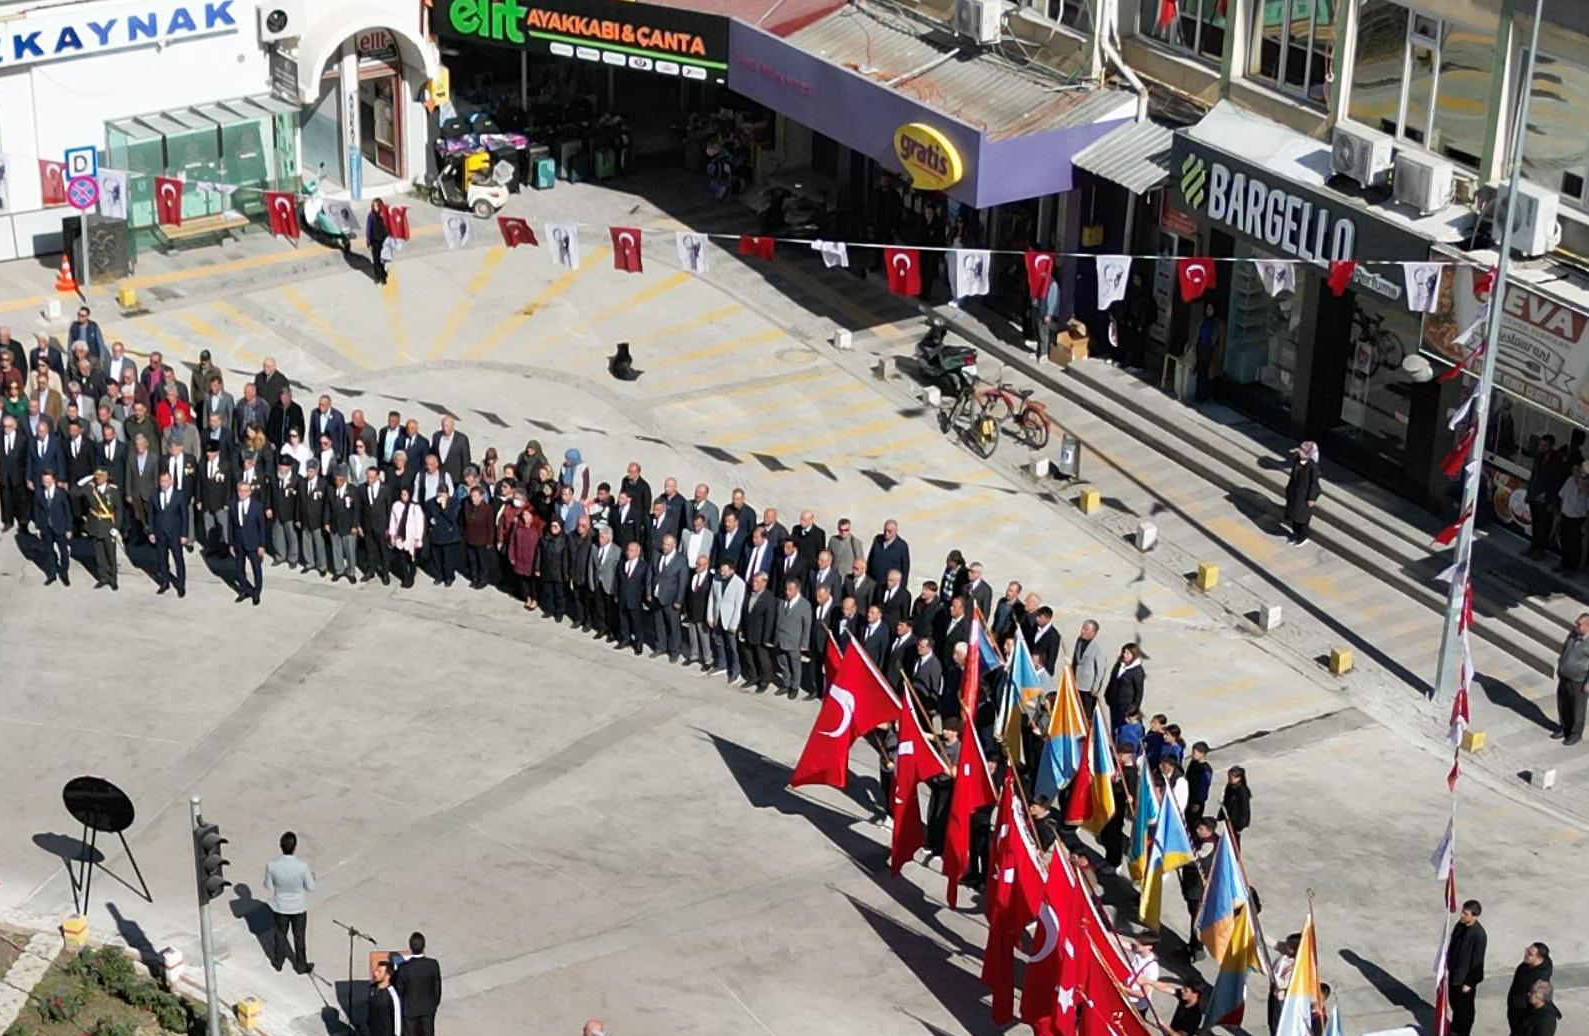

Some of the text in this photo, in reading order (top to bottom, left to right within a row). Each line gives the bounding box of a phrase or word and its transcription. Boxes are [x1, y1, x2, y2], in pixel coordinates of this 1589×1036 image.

[449, 0, 528, 43] elit
[526, 8, 621, 41] AYAKKABI
[636, 27, 707, 56] ÇANTA
[73, 155, 88, 173] D
[900, 133, 949, 176] gratis
[1208, 163, 1355, 269] BARGELLO
[1497, 286, 1574, 339] EVA
